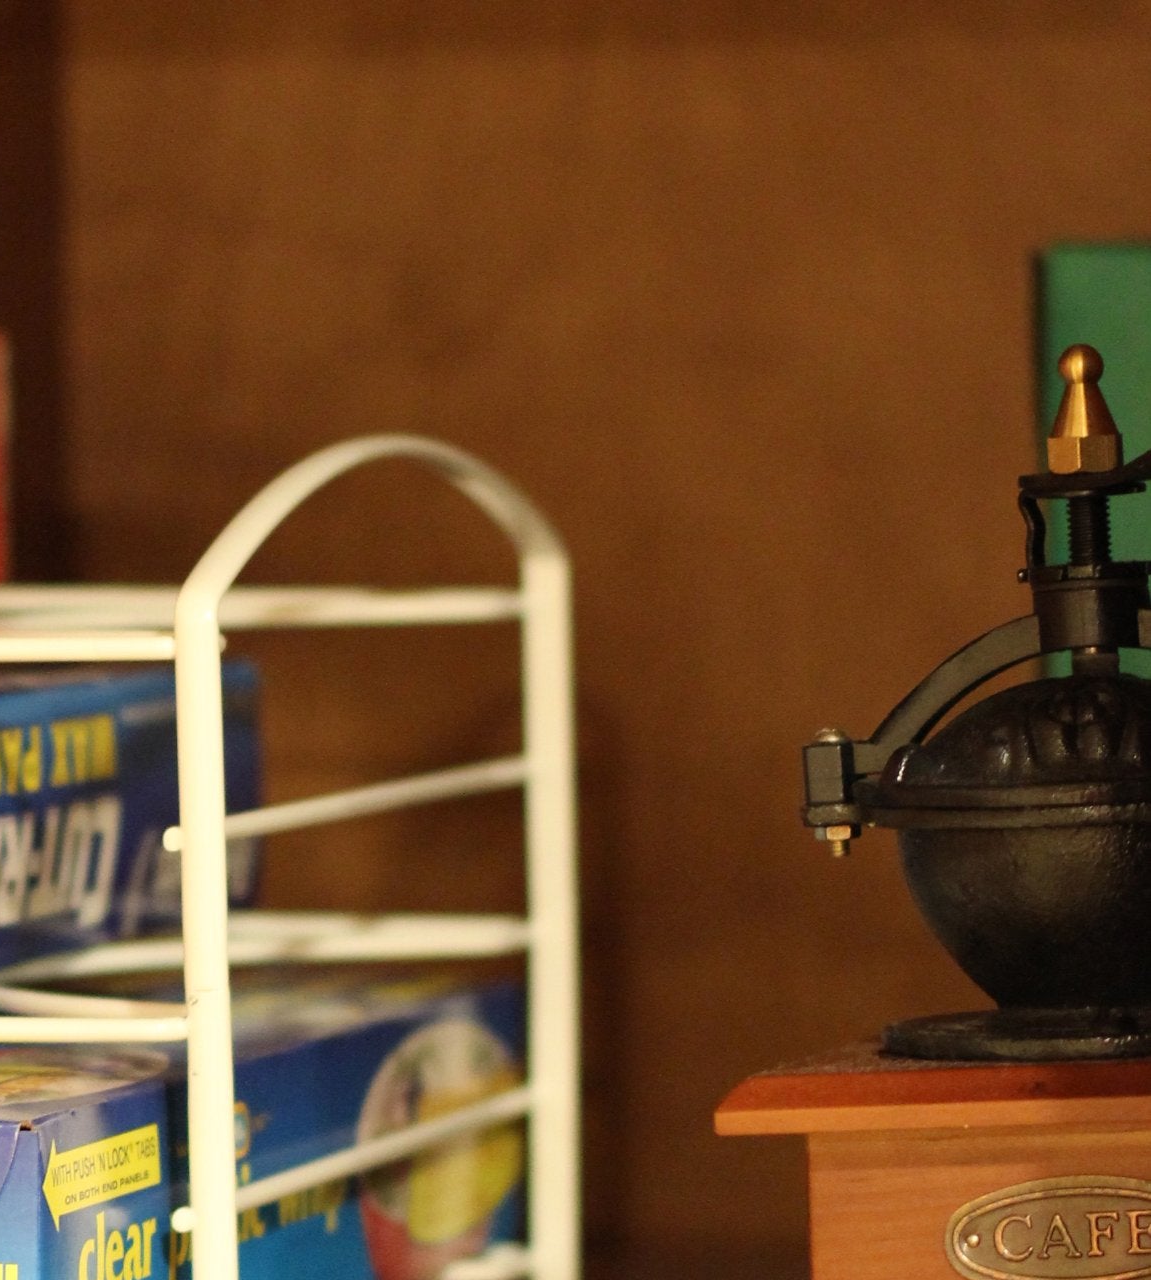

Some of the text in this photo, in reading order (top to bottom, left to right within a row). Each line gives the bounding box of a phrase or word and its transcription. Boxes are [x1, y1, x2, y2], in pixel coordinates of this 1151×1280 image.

[51, 1163, 72, 1188] WITH
[72, 1156, 96, 1181] PUSH
[135, 1136, 156, 1160] TABS
[64, 1169, 149, 1206] ON BOTH END PANELS
[993, 1210, 1151, 1263] CAFE
